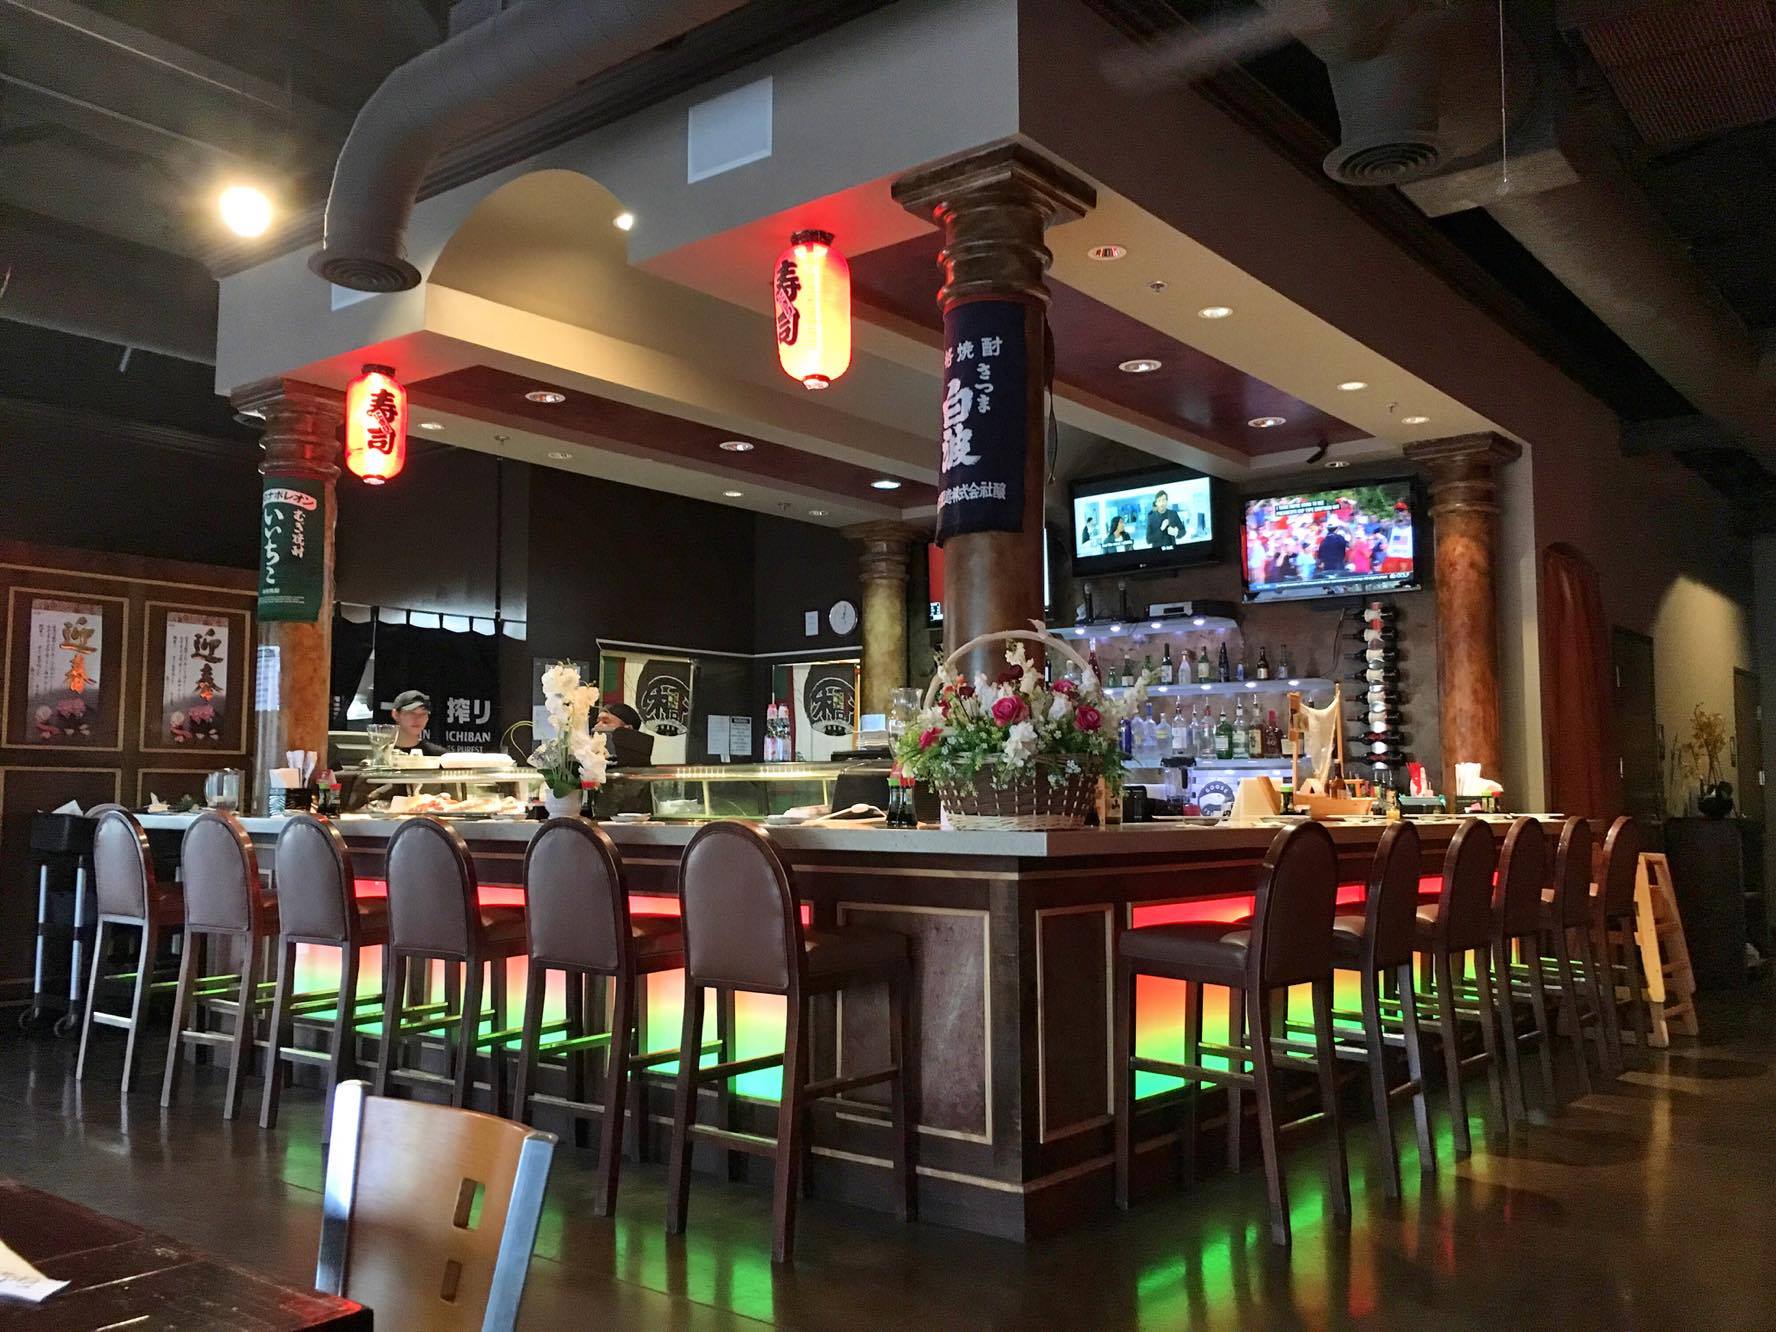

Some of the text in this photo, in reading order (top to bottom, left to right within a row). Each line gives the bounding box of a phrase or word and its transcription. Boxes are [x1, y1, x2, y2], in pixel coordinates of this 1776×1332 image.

[975, 363, 994, 414] さつま
[367, 389, 398, 455] 寿司
[942, 378, 982, 474] 白波
[264, 508, 285, 585] いいちこ
[190, 628, 224, 702] 迎春
[446, 730, 491, 743] ICHIBAN
[1205, 784, 1228, 794] GOOSE
